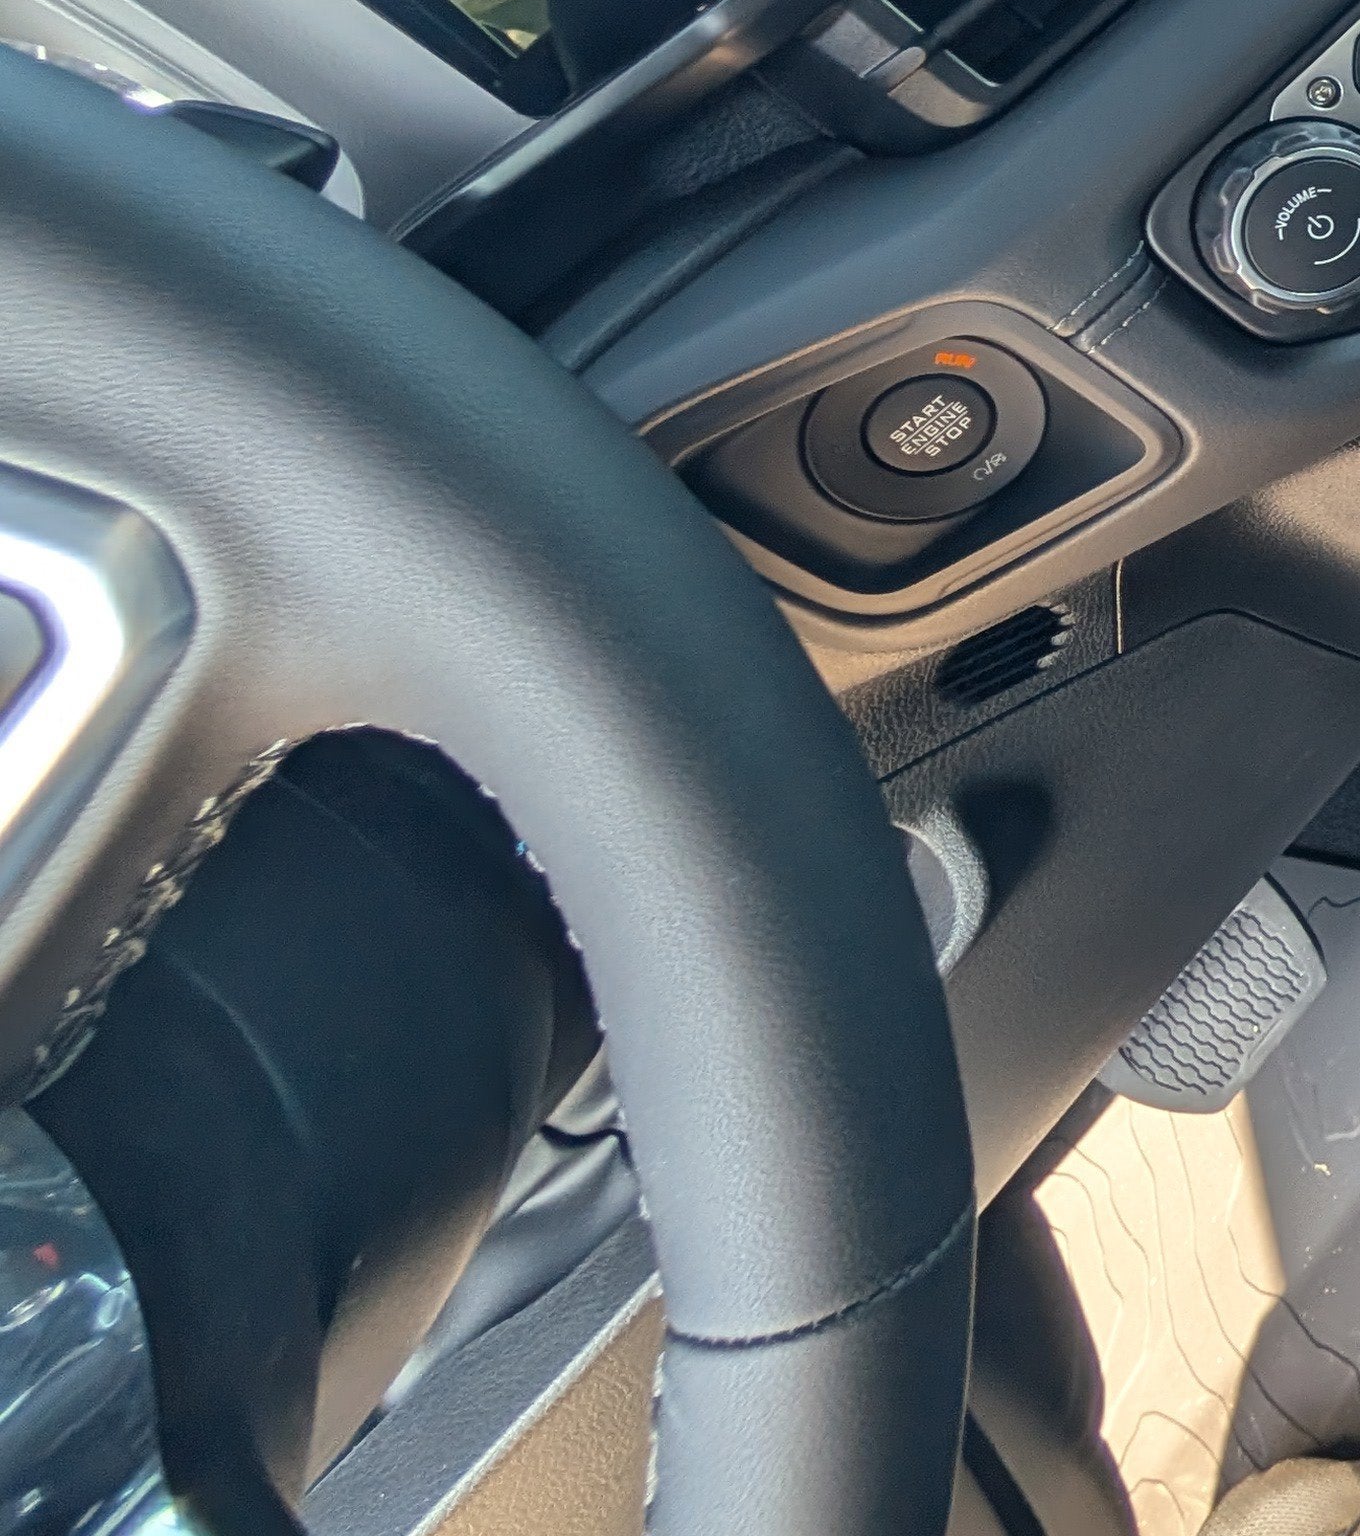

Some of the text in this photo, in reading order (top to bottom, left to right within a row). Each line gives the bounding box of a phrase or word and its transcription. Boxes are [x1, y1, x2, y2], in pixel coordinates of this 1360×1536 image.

[1275, 186, 1317, 229] VOLUME
[890, 394, 946, 443] START
[901, 401, 968, 456] ENGINE
[924, 416, 972, 457] STOP
